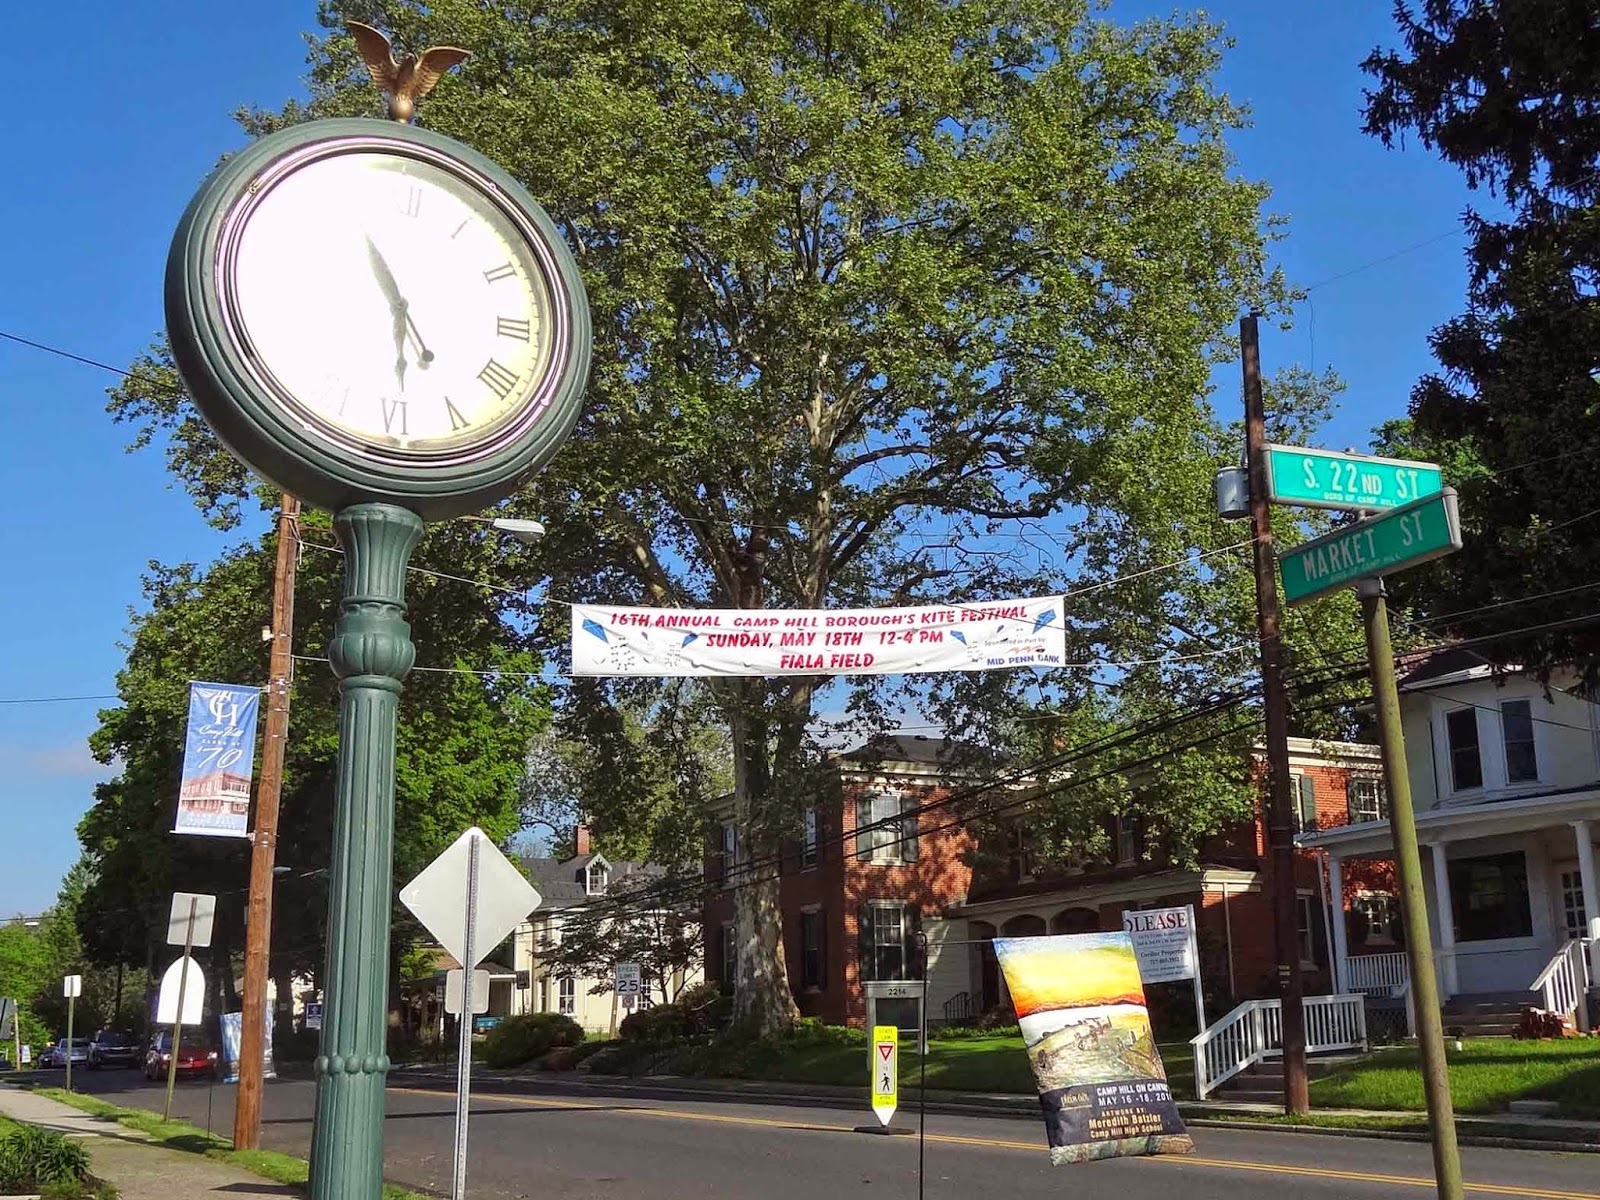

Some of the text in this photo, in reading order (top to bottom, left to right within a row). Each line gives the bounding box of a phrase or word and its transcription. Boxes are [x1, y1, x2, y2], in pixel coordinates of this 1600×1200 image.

[497, 315, 530, 343] III
[1303, 458, 1418, 500] S. 22ND ST
[1302, 510, 1423, 582] MARKET ST
[655, 614, 721, 628] ANNUAL
[733, 617, 780, 627] CAMP
[784, 616, 819, 627] HILL
[825, 613, 916, 627] BOROUGH'S
[921, 610, 955, 624] KITE
[960, 605, 1028, 622] FESTIVAL
[706, 630, 944, 649] SUNDAY, MAY 18TH 12-4 PM
[780, 652, 875, 669] FIALA FIELD
[986, 658, 1005, 666] MID
[1008, 655, 1034, 665] PENN
[618, 980, 639, 992] 25
[1096, 1085, 1118, 1097] CAMP
[1118, 1084, 1135, 1095] HILL
[1135, 1083, 1147, 1094] ON
[1098, 1096, 1117, 1106] MAY
[1088, 1115, 1129, 1129] Meredith
[1090, 1129, 1110, 1138] Camp
[1111, 1127, 1123, 1136] Hill
